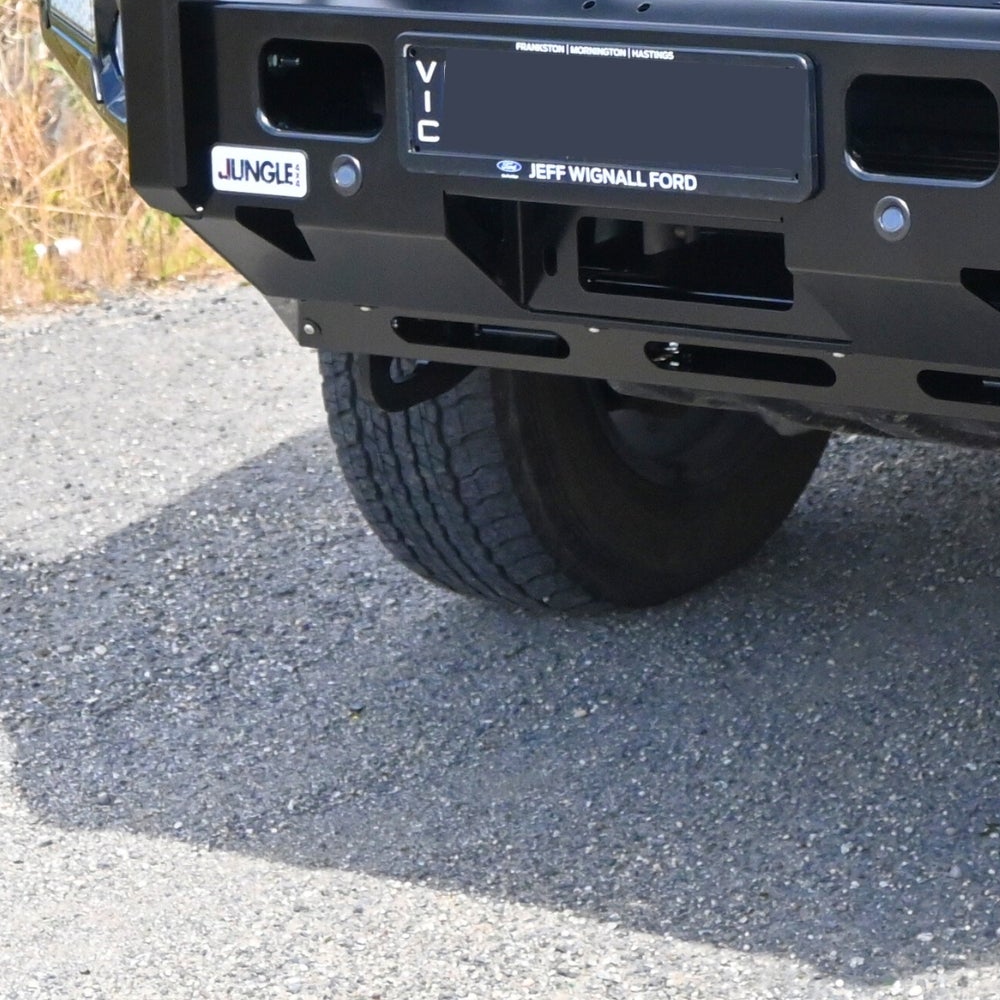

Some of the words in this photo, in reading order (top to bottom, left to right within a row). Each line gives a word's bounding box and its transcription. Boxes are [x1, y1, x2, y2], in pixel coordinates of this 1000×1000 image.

[515, 42, 565, 55] FRANKSTON
[570, 46, 627, 58] MORNINGTON
[631, 49, 674, 61] HASTINGS
[415, 60, 440, 142] VIC
[218, 158, 294, 185] JUNGLE
[529, 163, 567, 181] JEFF
[568, 165, 648, 188] WIGNALL
[649, 171, 698, 191] FORD
